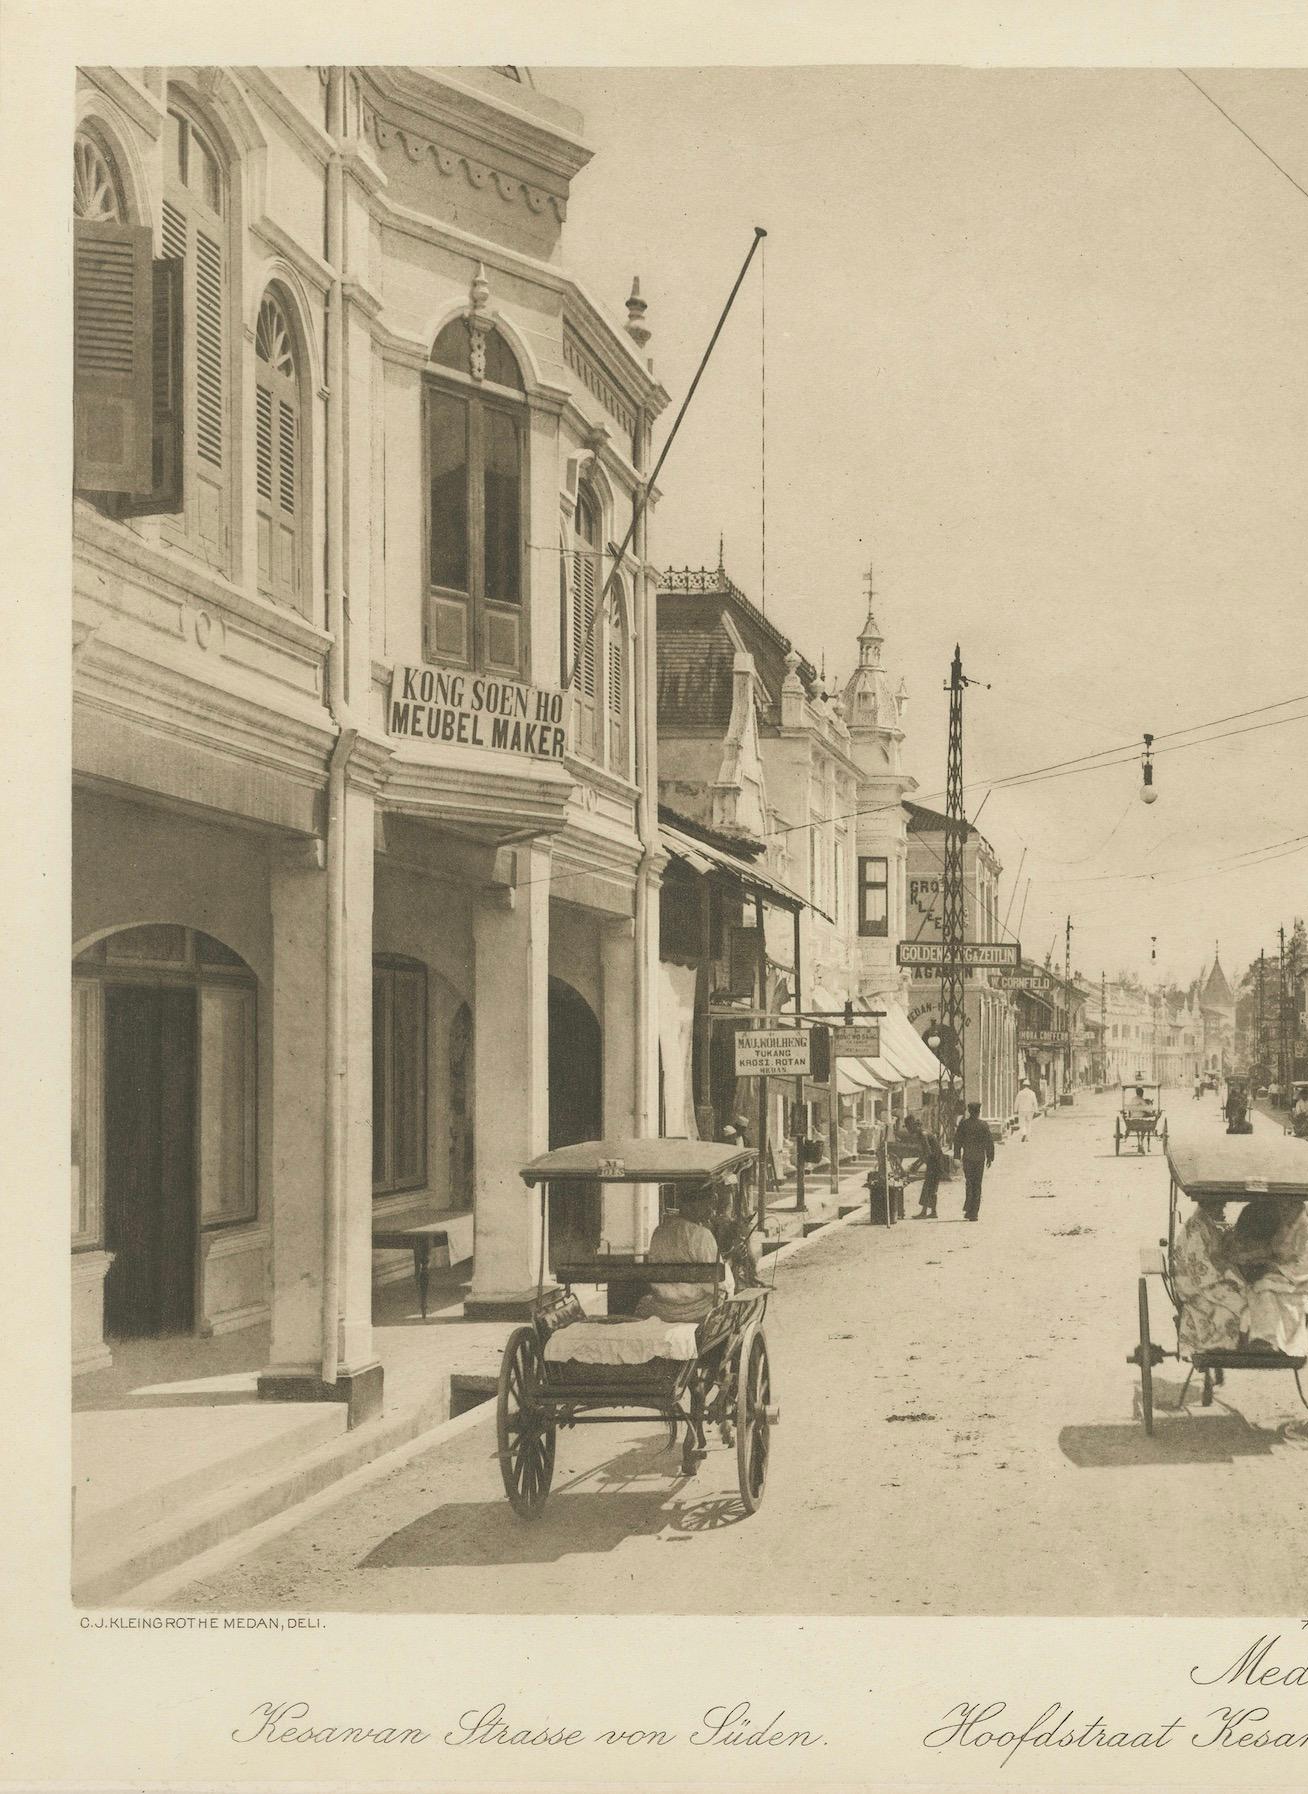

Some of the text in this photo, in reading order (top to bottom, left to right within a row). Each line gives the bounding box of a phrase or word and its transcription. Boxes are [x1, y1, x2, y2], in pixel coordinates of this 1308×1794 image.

[402, 667, 563, 724] KONG SOEN HO
[391, 701, 565, 758] MEUBEL MAKER
[754, 1049, 791, 1058] TUKANG
